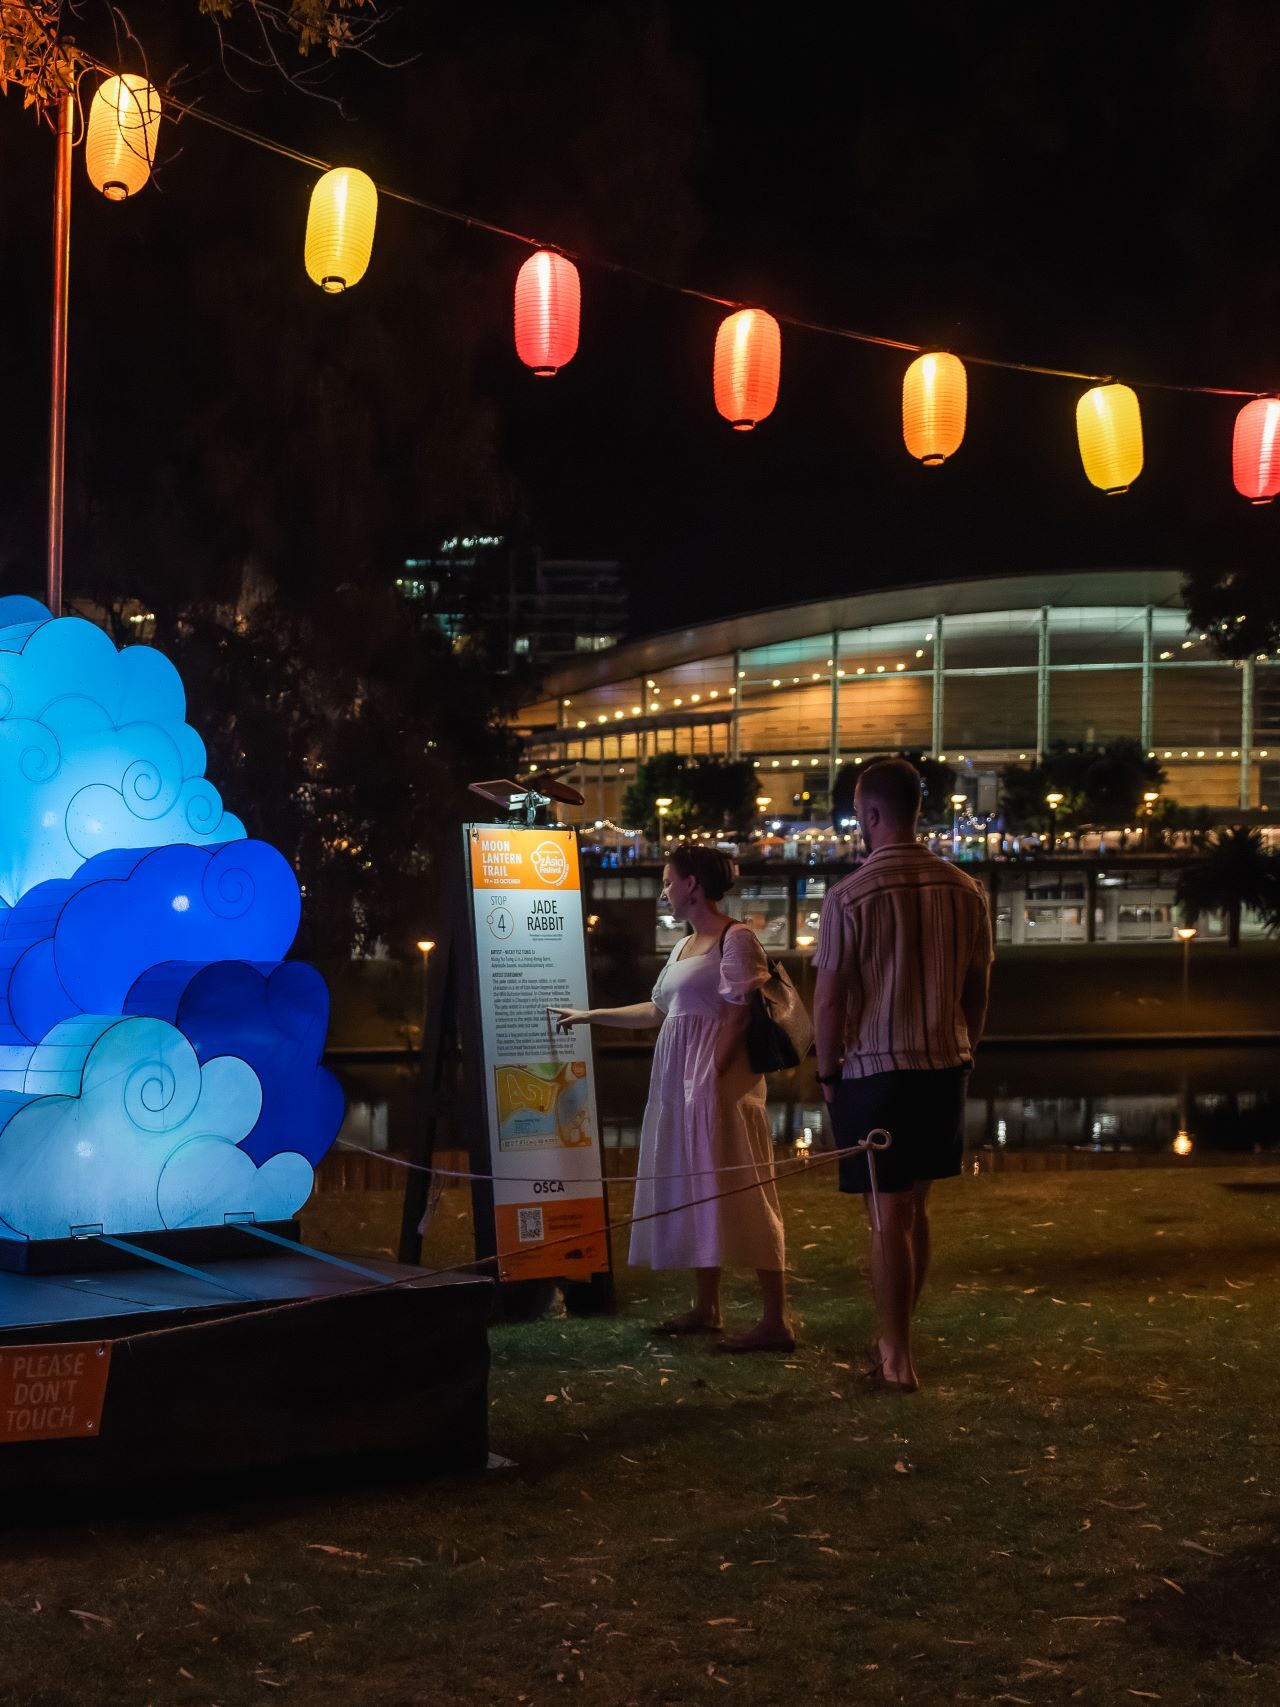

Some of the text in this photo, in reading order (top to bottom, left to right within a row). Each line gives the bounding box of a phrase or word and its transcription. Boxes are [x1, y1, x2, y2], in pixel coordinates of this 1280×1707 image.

[481, 840, 510, 851] MOON
[482, 853, 523, 864] LANTERN
[482, 865, 508, 876] TRAIL
[491, 895, 507, 906] STOP
[530, 900, 558, 914] JADE
[497, 914, 506, 932] 4
[527, 916, 564, 931] RABBIT
[533, 1181, 565, 1193] OSCA
[12, 1353, 85, 1379] PLEASE
[14, 1380, 77, 1406] DON'T
[7, 1406, 75, 1432] TOUCH
